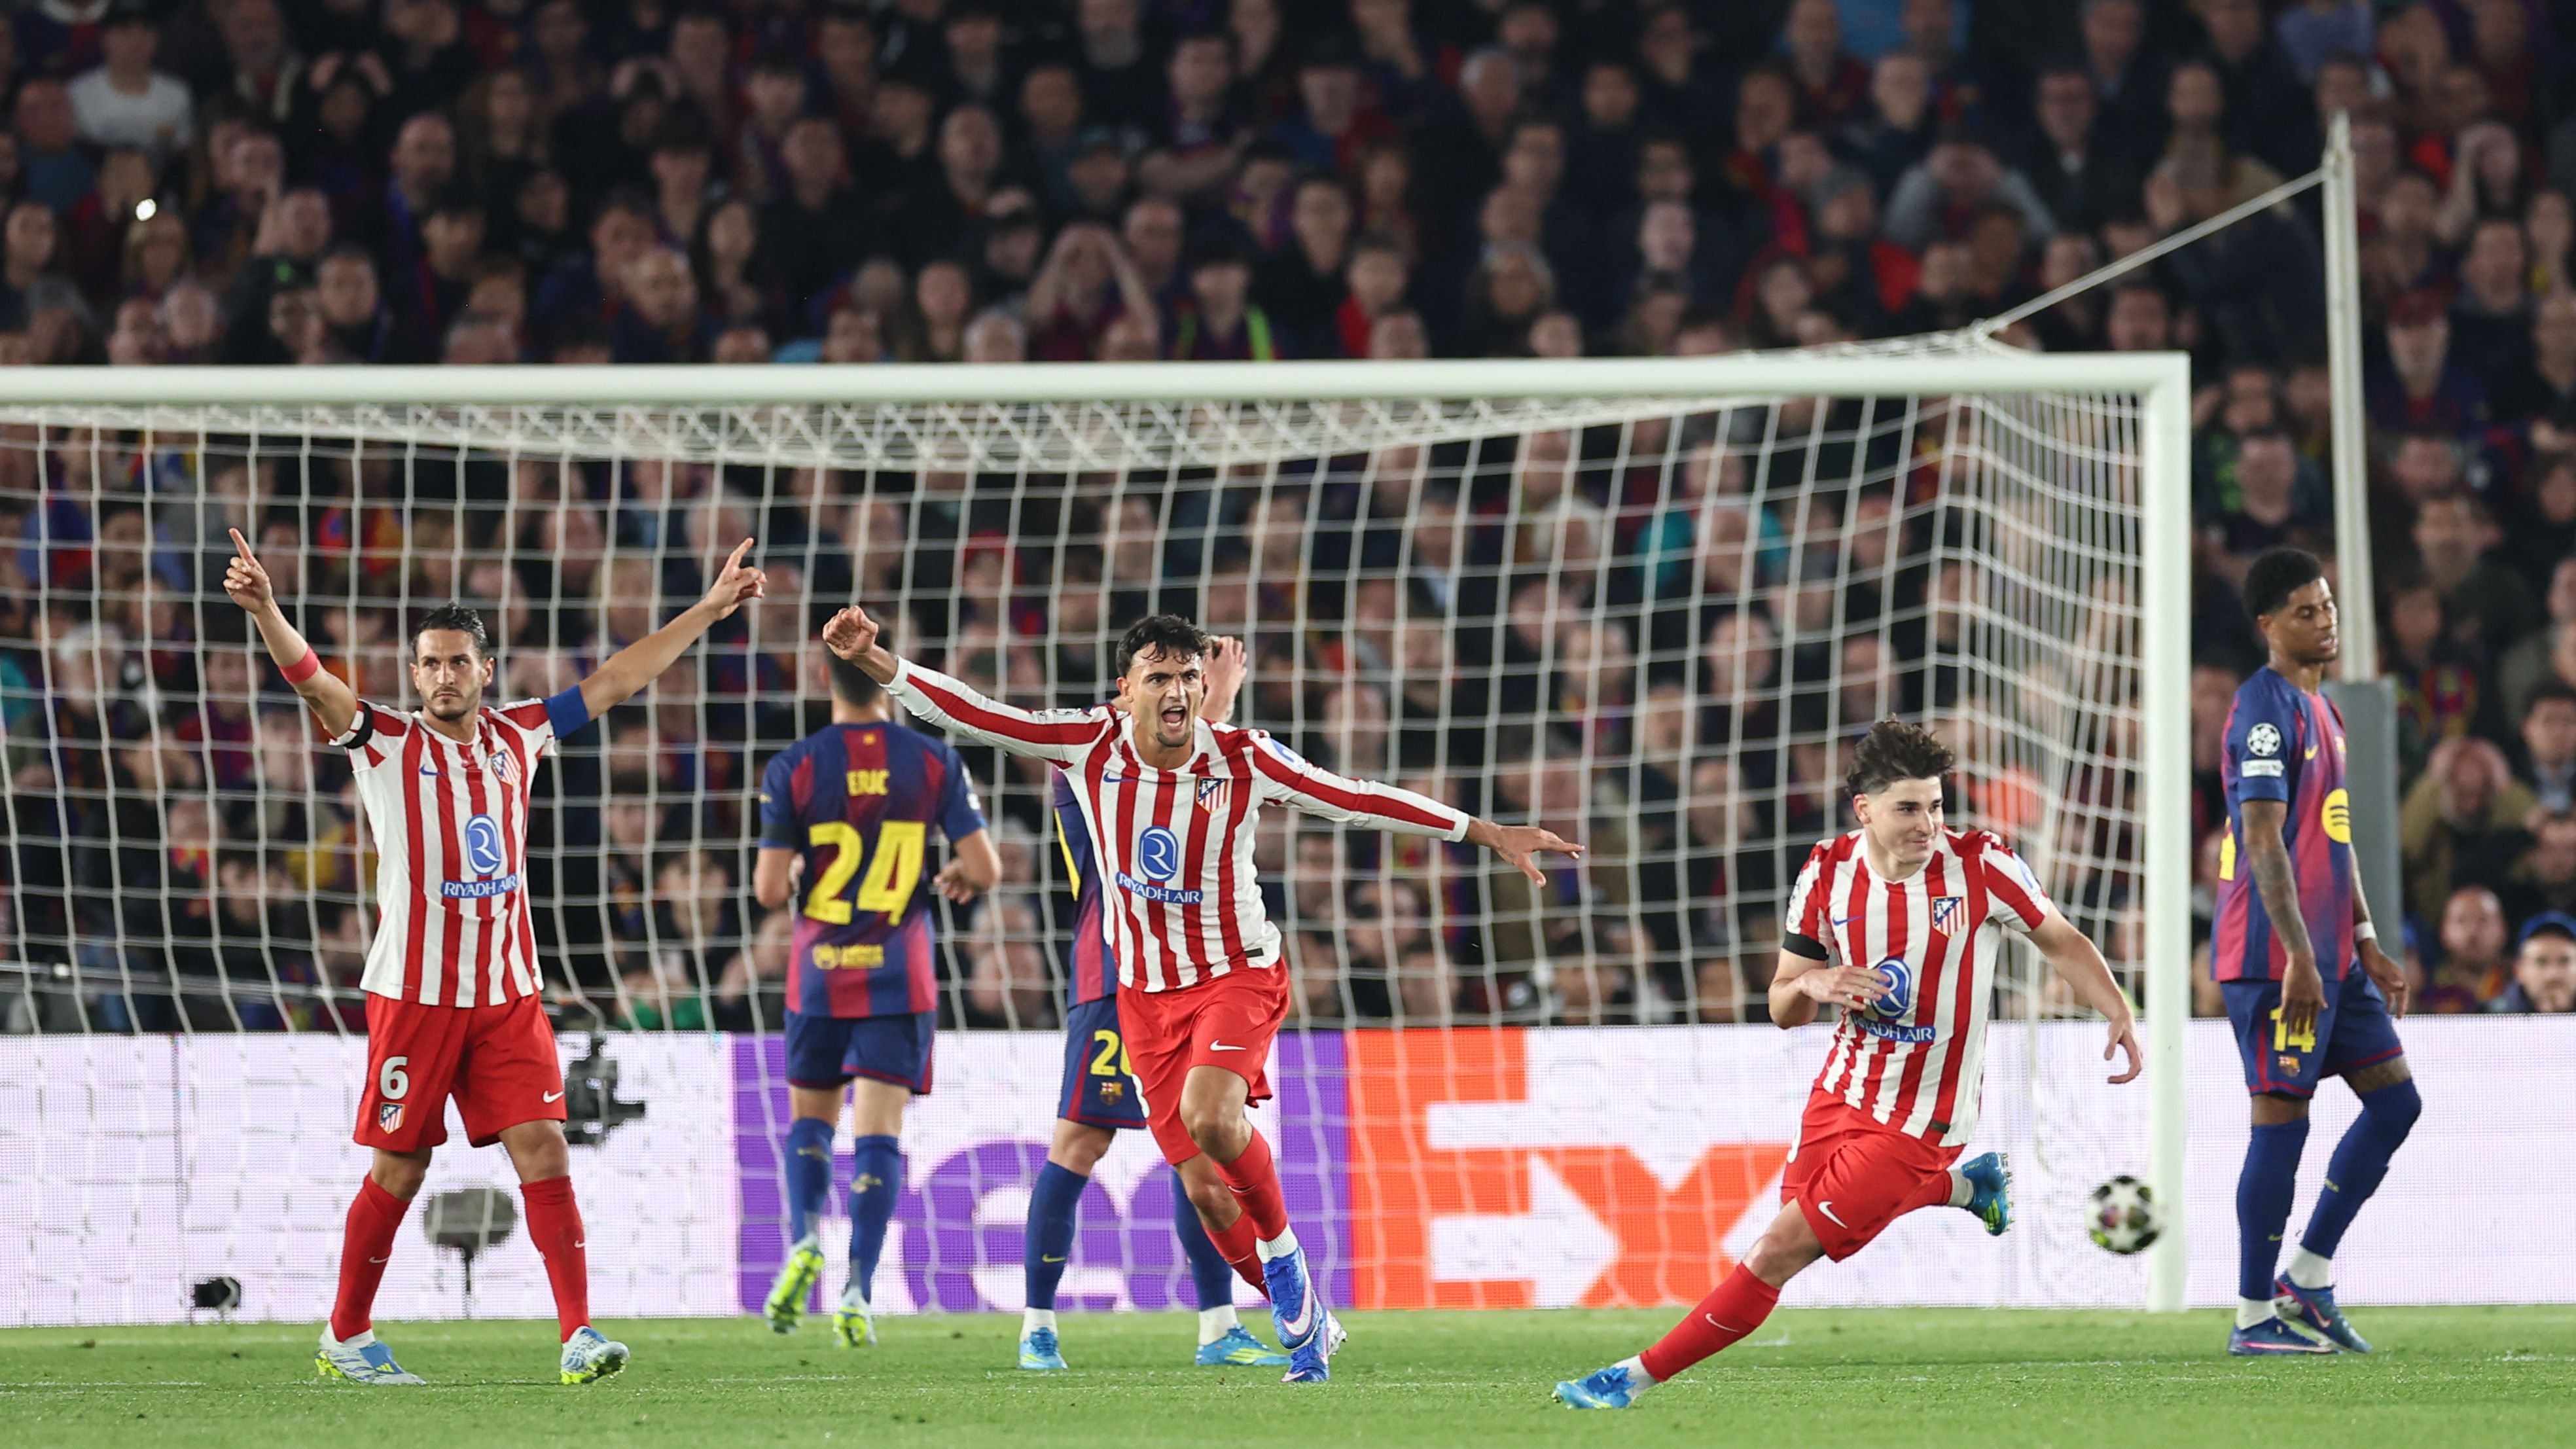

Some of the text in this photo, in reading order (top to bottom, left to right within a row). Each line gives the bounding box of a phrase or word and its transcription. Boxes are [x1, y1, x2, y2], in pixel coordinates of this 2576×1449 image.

[846, 768, 889, 796] ERIC
[444, 875, 516, 897] RIYADH AIR
[804, 820, 926, 927] 24
[1118, 872, 1200, 903] RIYADH AIR
[1905, 1028, 1933, 1041] AIR
[380, 1056, 410, 1100] 6
